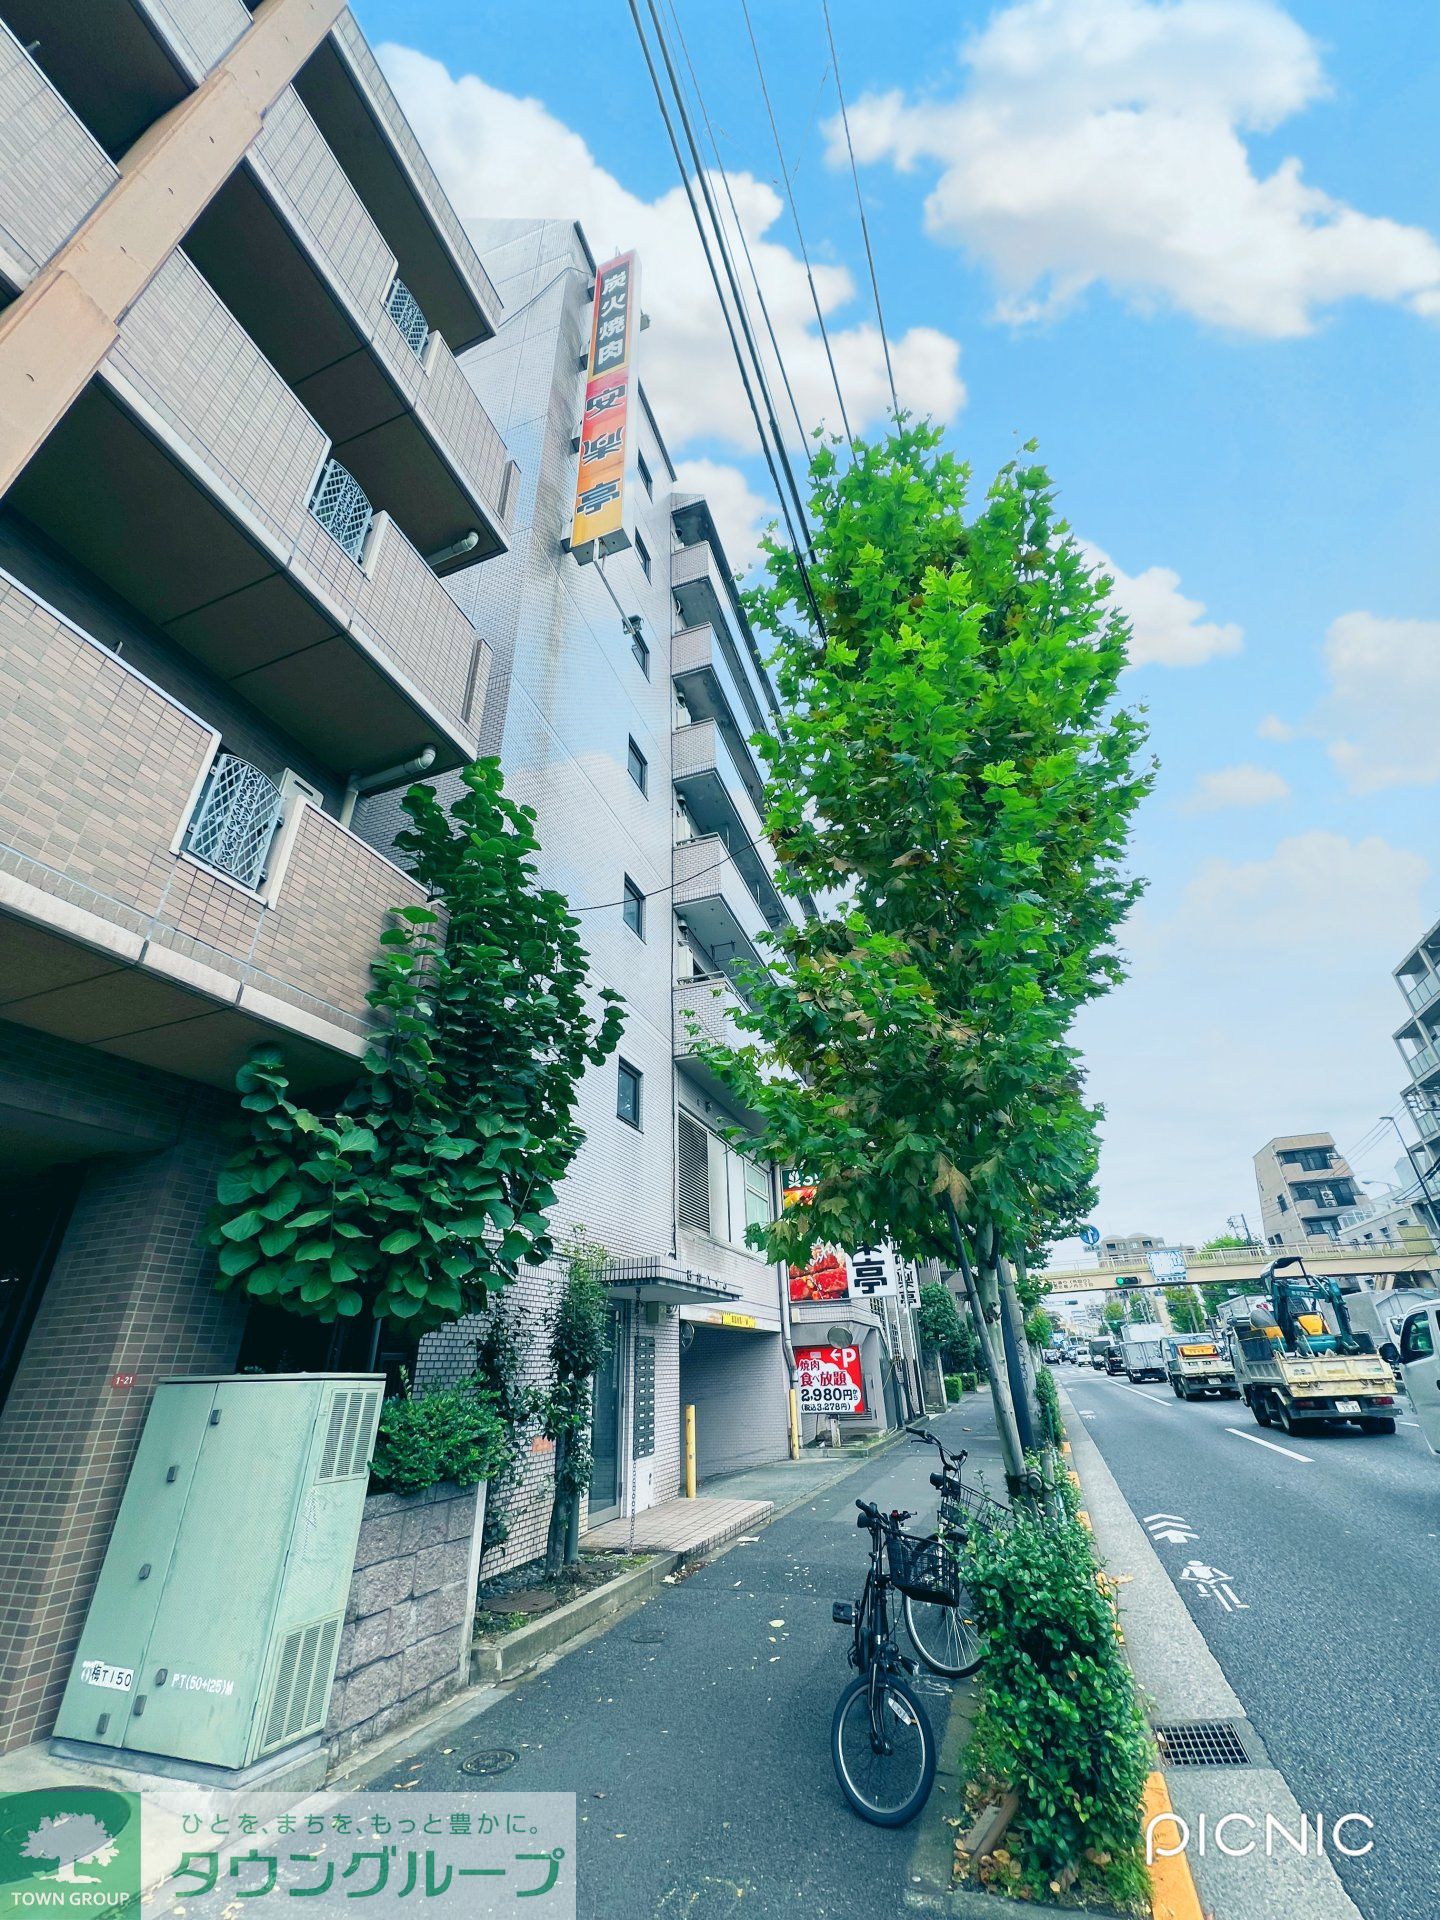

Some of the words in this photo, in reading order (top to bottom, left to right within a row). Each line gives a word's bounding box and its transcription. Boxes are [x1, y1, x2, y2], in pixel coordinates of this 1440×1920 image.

[599, 270, 625, 365] 炭火焼肉
[577, 385, 625, 515] 安楽亭
[799, 1360, 820, 1371] 焼肉
[841, 1348, 857, 1368] P
[115, 1376, 133, 1385] 1-21
[800, 1371, 848, 1387] 食べ放題
